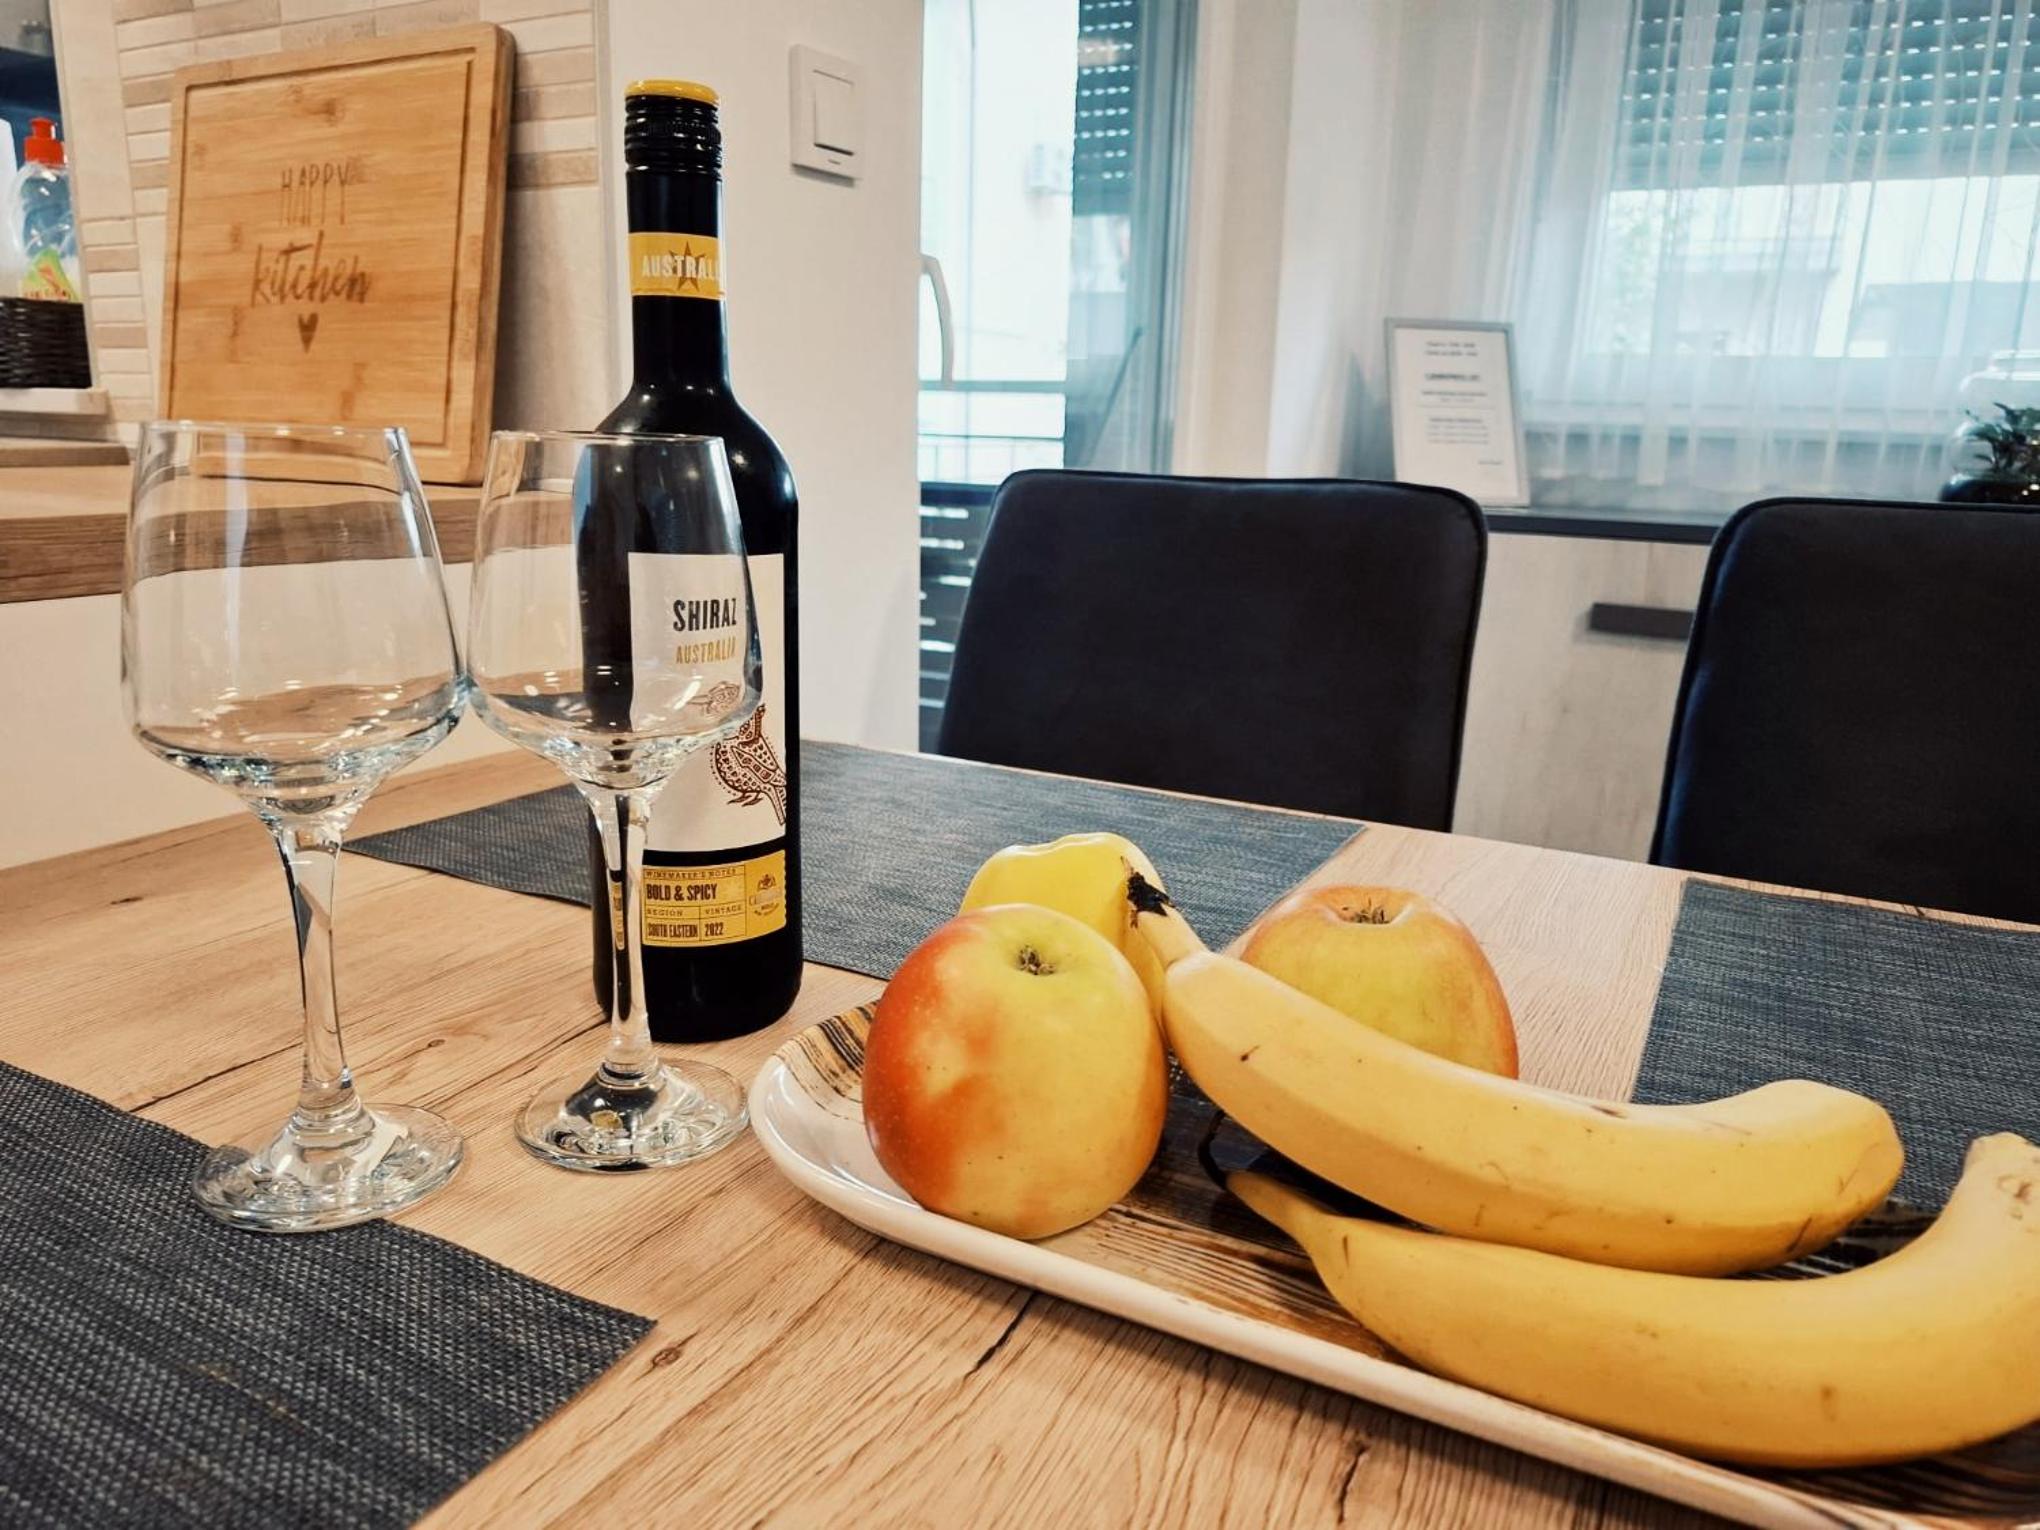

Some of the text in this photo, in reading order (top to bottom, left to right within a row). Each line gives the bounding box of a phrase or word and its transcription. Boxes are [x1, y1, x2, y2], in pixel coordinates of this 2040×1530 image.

[281, 162, 351, 226] HAPPY
[250, 229, 371, 309] kitchen
[673, 598, 737, 632] SHIRAZ
[646, 883, 718, 901] BOLD & SPICY
[647, 904, 742, 917] REGION VINTAGE
[648, 922, 724, 938] SOUTH EASTERN 2022
